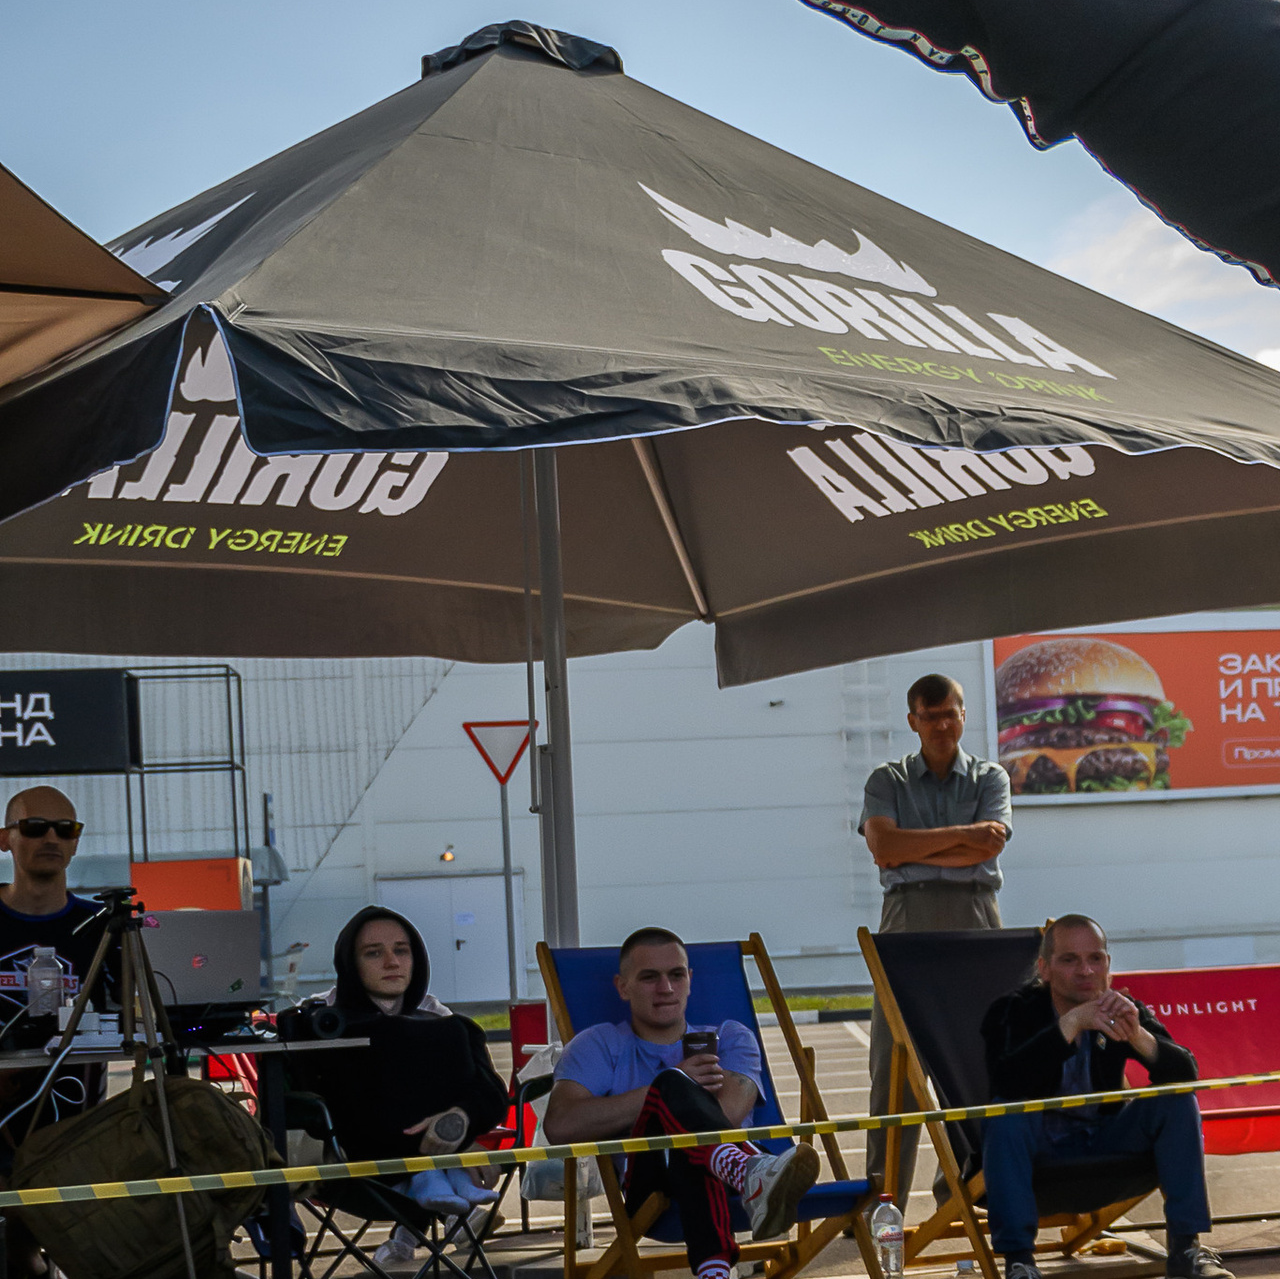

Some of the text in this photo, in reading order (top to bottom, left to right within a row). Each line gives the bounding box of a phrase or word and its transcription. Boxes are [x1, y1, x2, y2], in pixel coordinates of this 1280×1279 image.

[661, 248, 1118, 380] GORILLA
[817, 346, 1115, 404] ENERGY DRINK
[1219, 679, 1243, 699] И
[1220, 702, 1265, 723] НА
[1146, 998, 1258, 1016] SUNLIGHT
